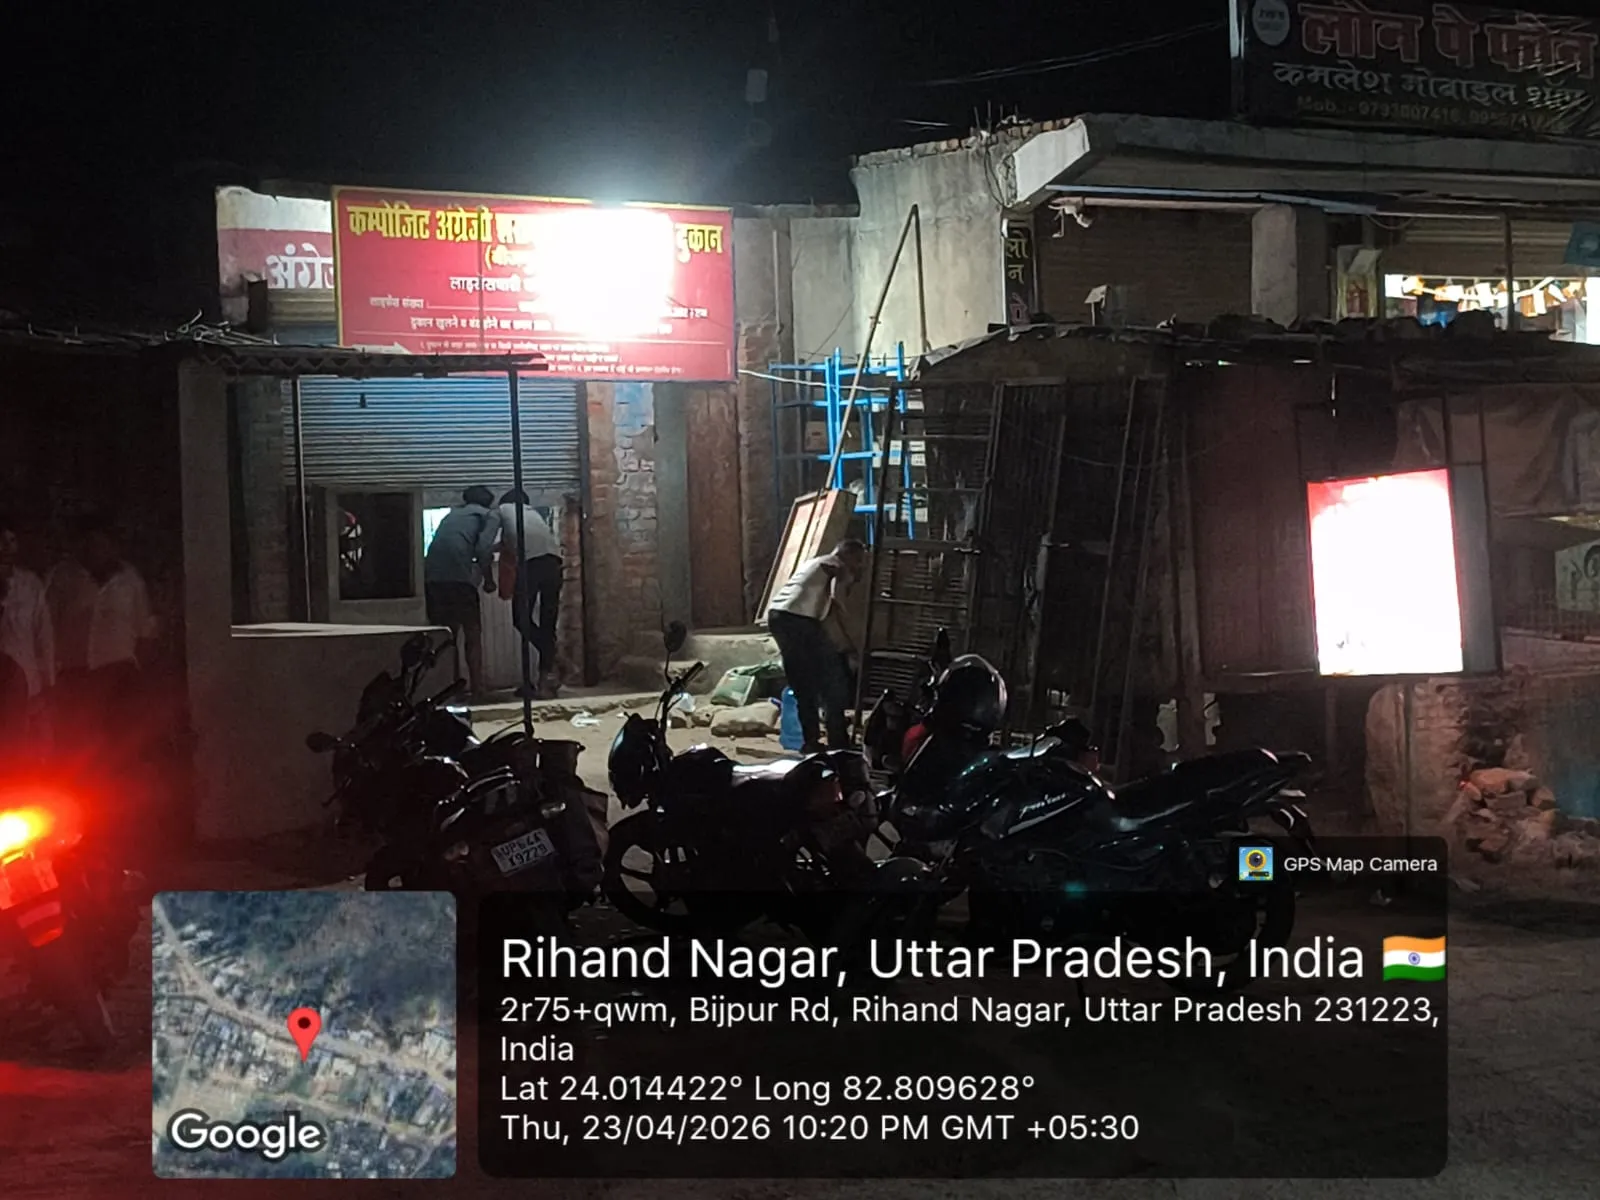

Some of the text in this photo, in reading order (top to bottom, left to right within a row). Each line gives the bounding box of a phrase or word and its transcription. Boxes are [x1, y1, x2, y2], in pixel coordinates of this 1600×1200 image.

[1298, 0, 1424, 63] लोन
[1432, 3, 1479, 69] पे
[1272, 59, 1393, 95] कमलेश
[1399, 66, 1519, 107] मोबाइल
[346, 200, 430, 239] कम्पोजिट
[435, 203, 493, 243] अंग्रेजी
